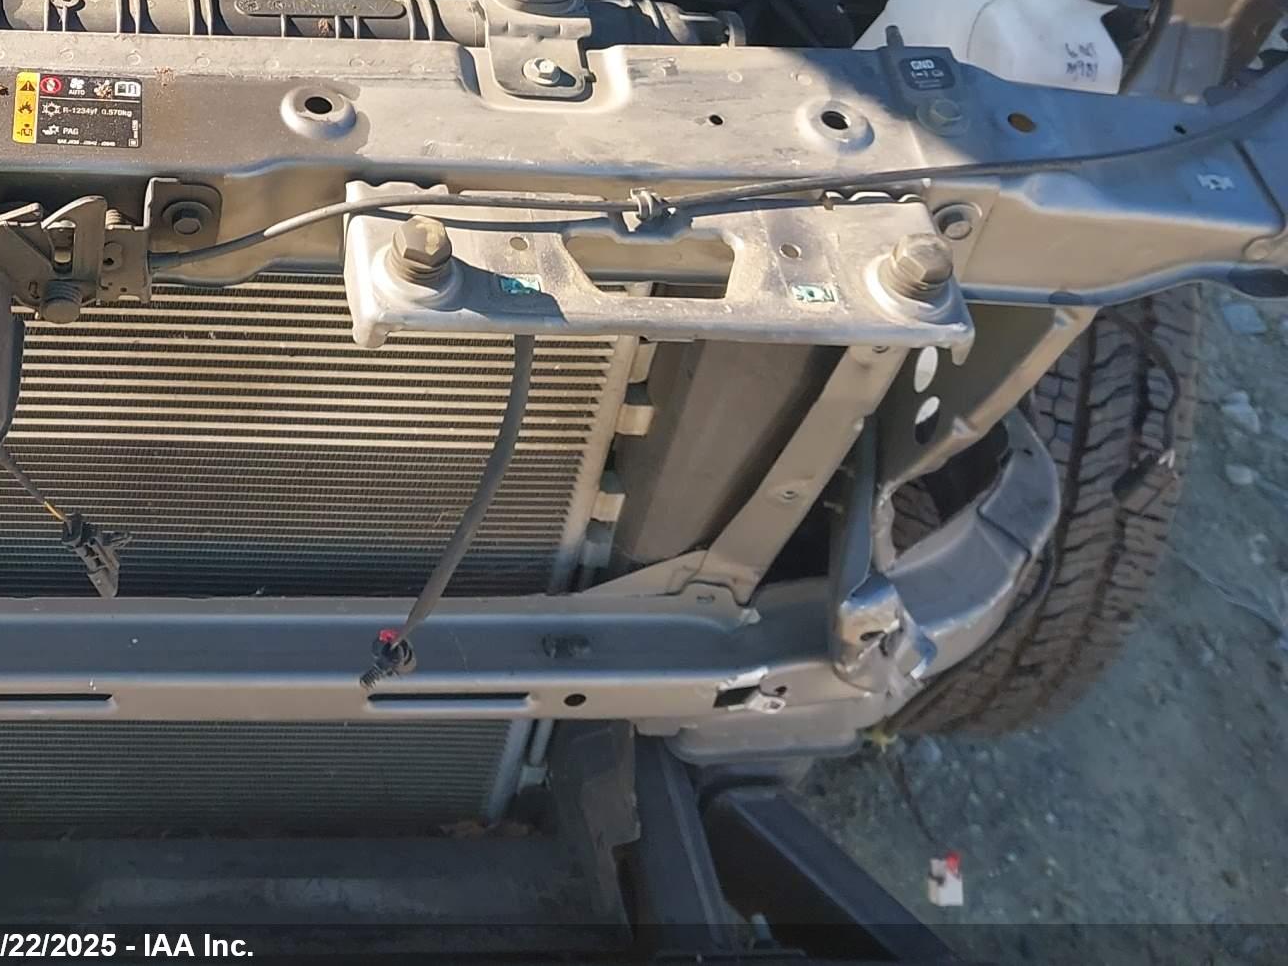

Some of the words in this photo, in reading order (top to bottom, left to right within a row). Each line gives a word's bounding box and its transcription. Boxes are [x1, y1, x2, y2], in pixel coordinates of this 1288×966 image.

[62, 106, 98, 115] R-1234yf
[101, 109, 132, 117] 0.570kg
[62, 127, 79, 135] PAG
